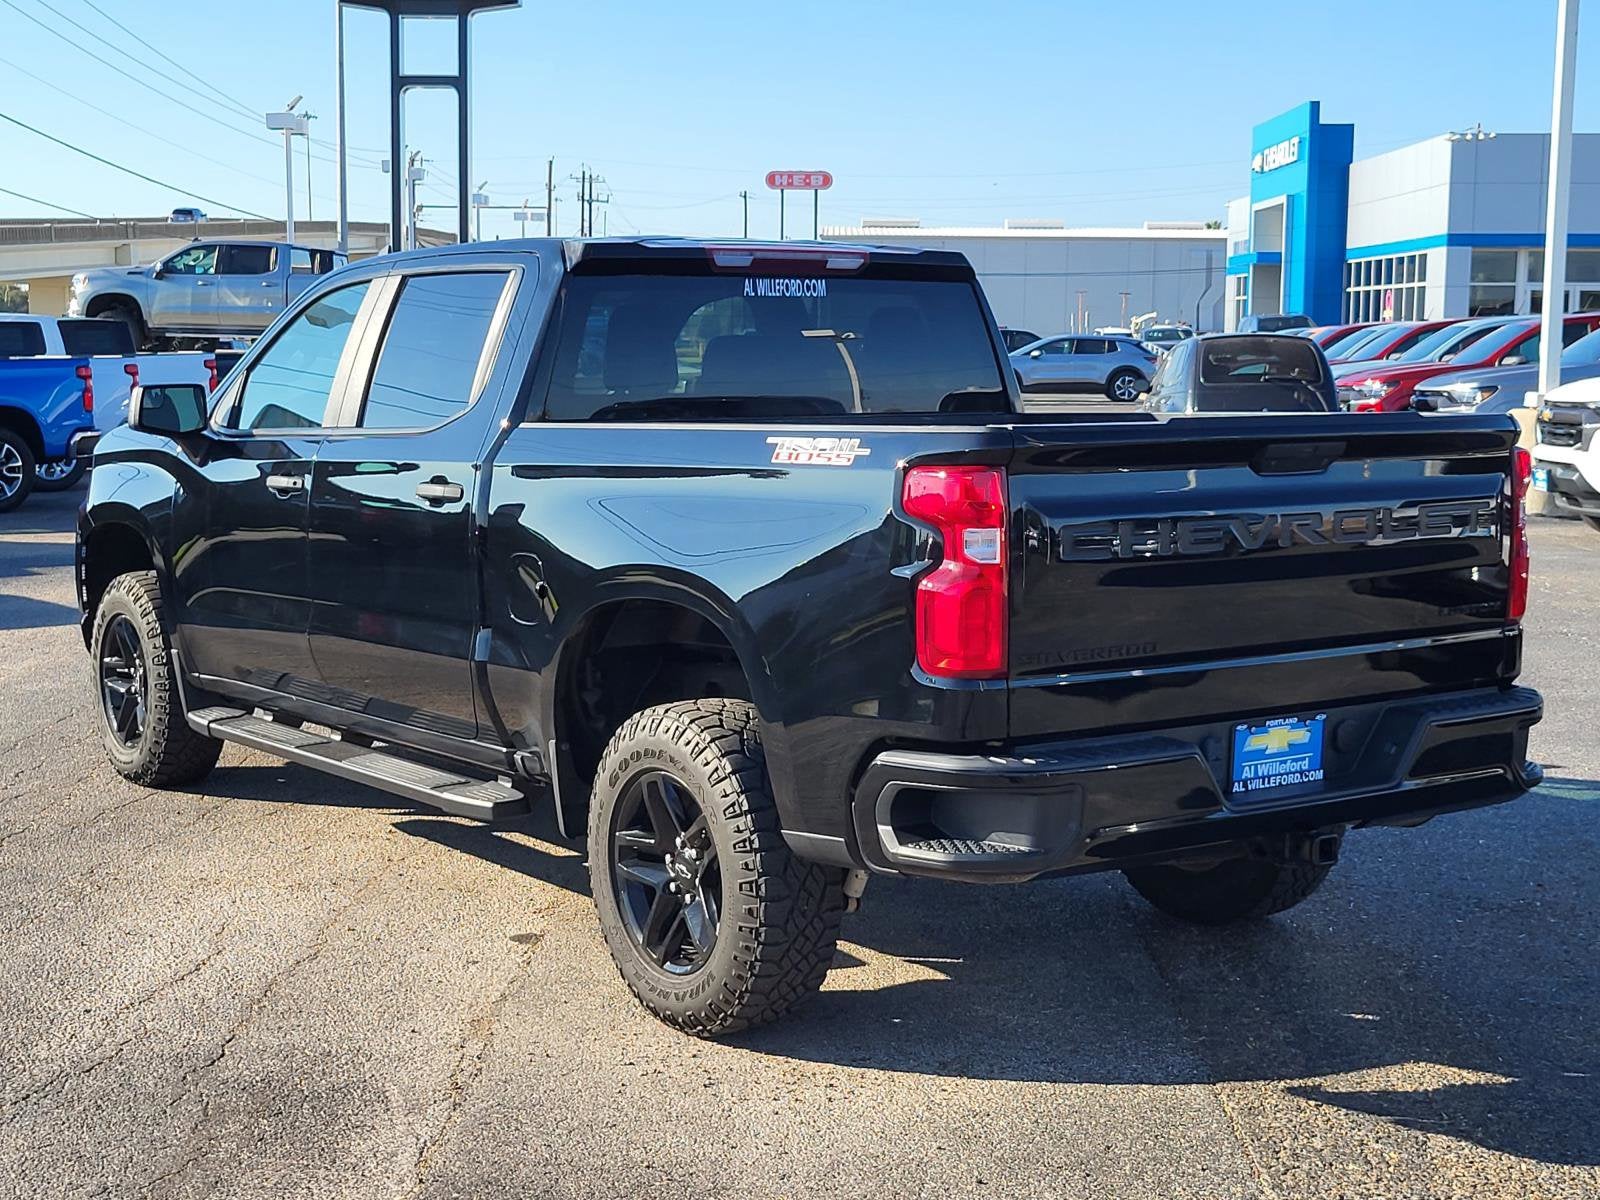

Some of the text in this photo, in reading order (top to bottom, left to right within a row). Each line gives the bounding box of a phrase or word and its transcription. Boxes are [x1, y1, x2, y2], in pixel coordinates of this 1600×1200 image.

[743, 278, 827, 297] AL WILLEFORD.COM
[1060, 501, 1491, 561] CHEVROLET
[1017, 641, 1158, 666] SILVERADO
[1265, 717, 1298, 727] PORTLAND
[1241, 757, 1309, 779] Al Willeford
[1232, 769, 1324, 793] AL WILLEFORD.COM
